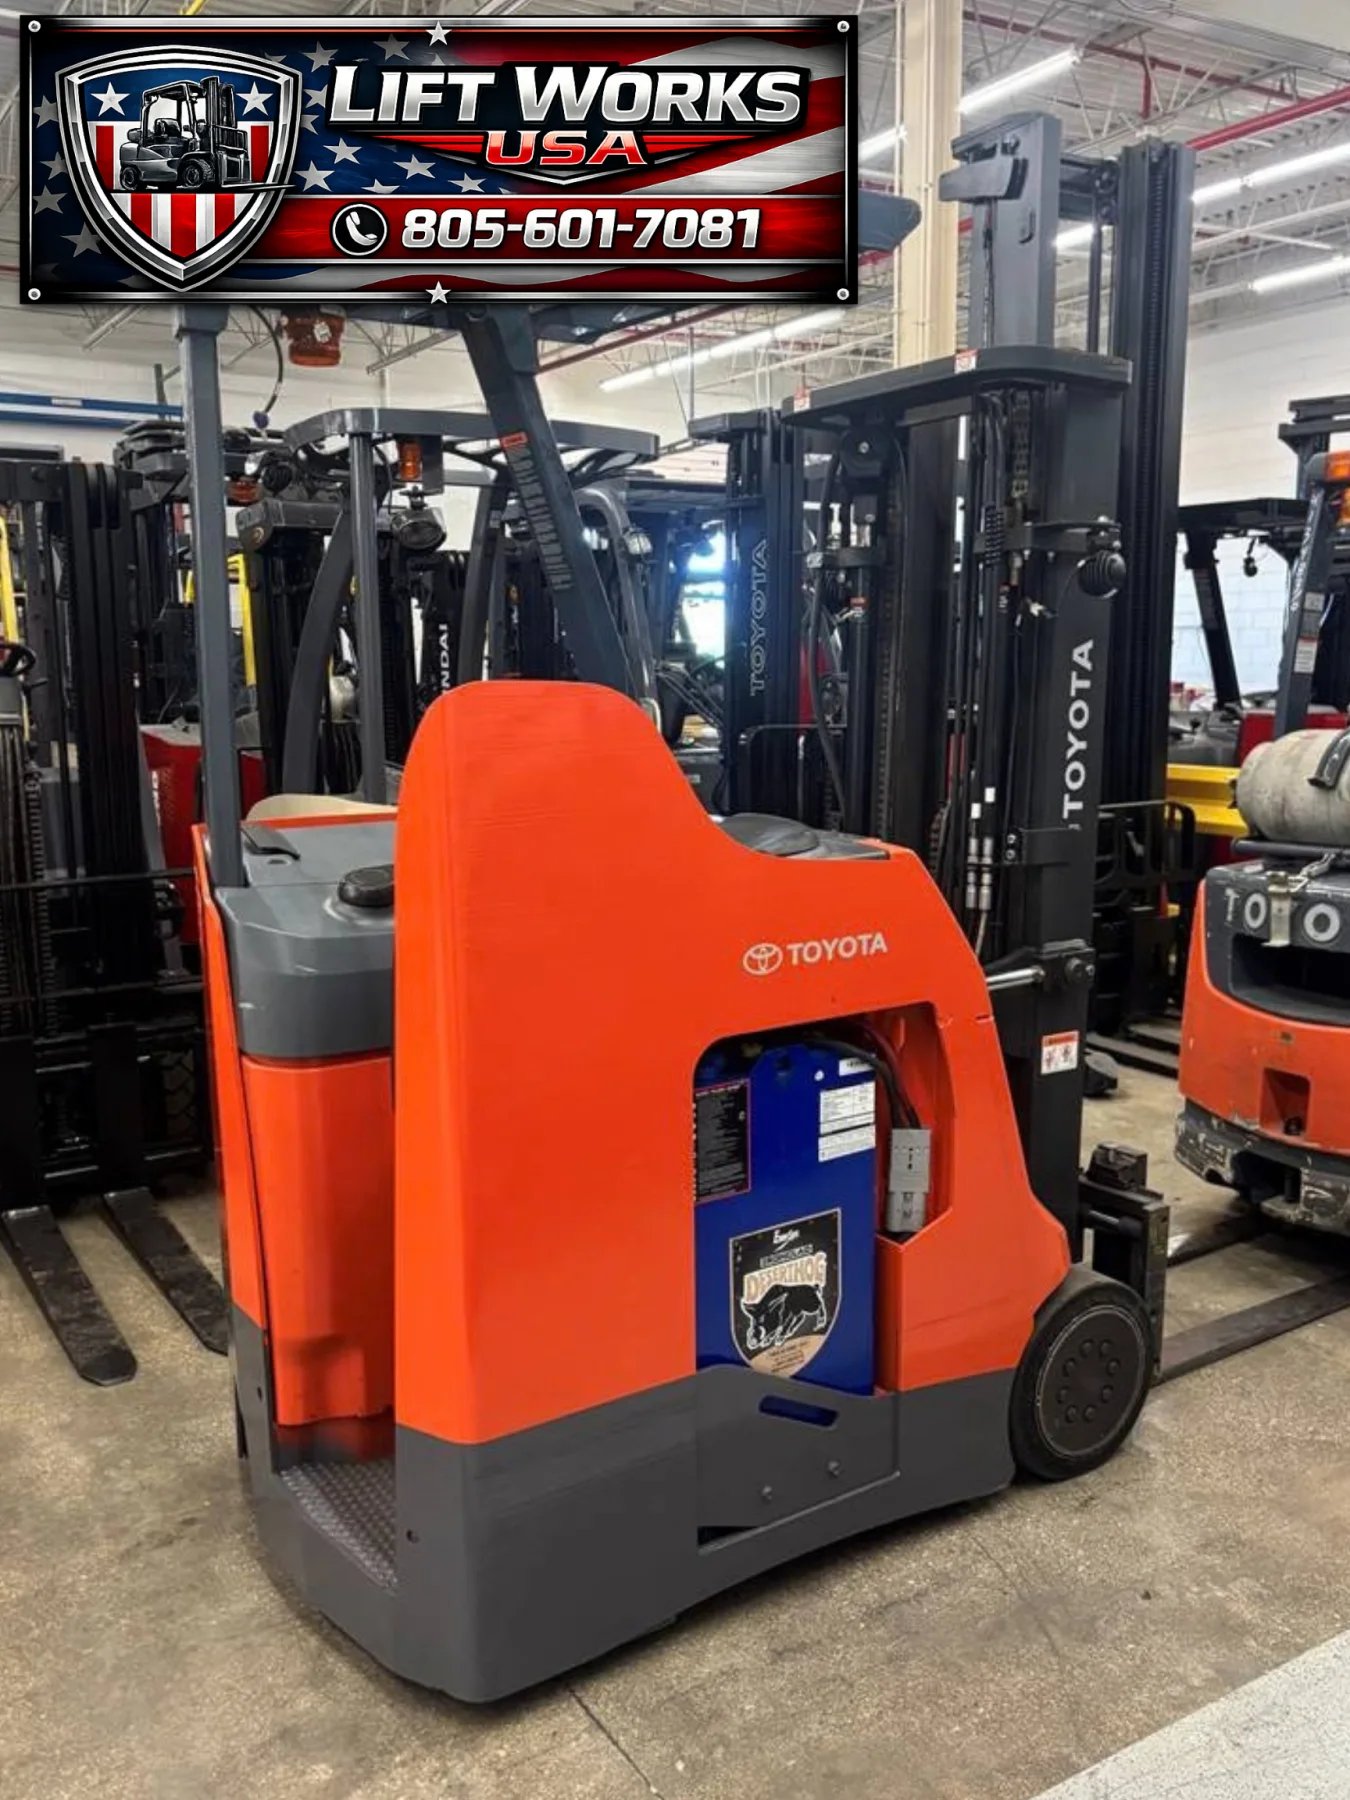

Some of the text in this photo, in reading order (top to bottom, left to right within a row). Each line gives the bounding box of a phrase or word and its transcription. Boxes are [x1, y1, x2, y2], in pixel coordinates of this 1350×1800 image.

[750, 538, 768, 697] TOYOTA
[1062, 639, 1094, 820] TOYOTA
[786, 931, 888, 966] TOYOTA
